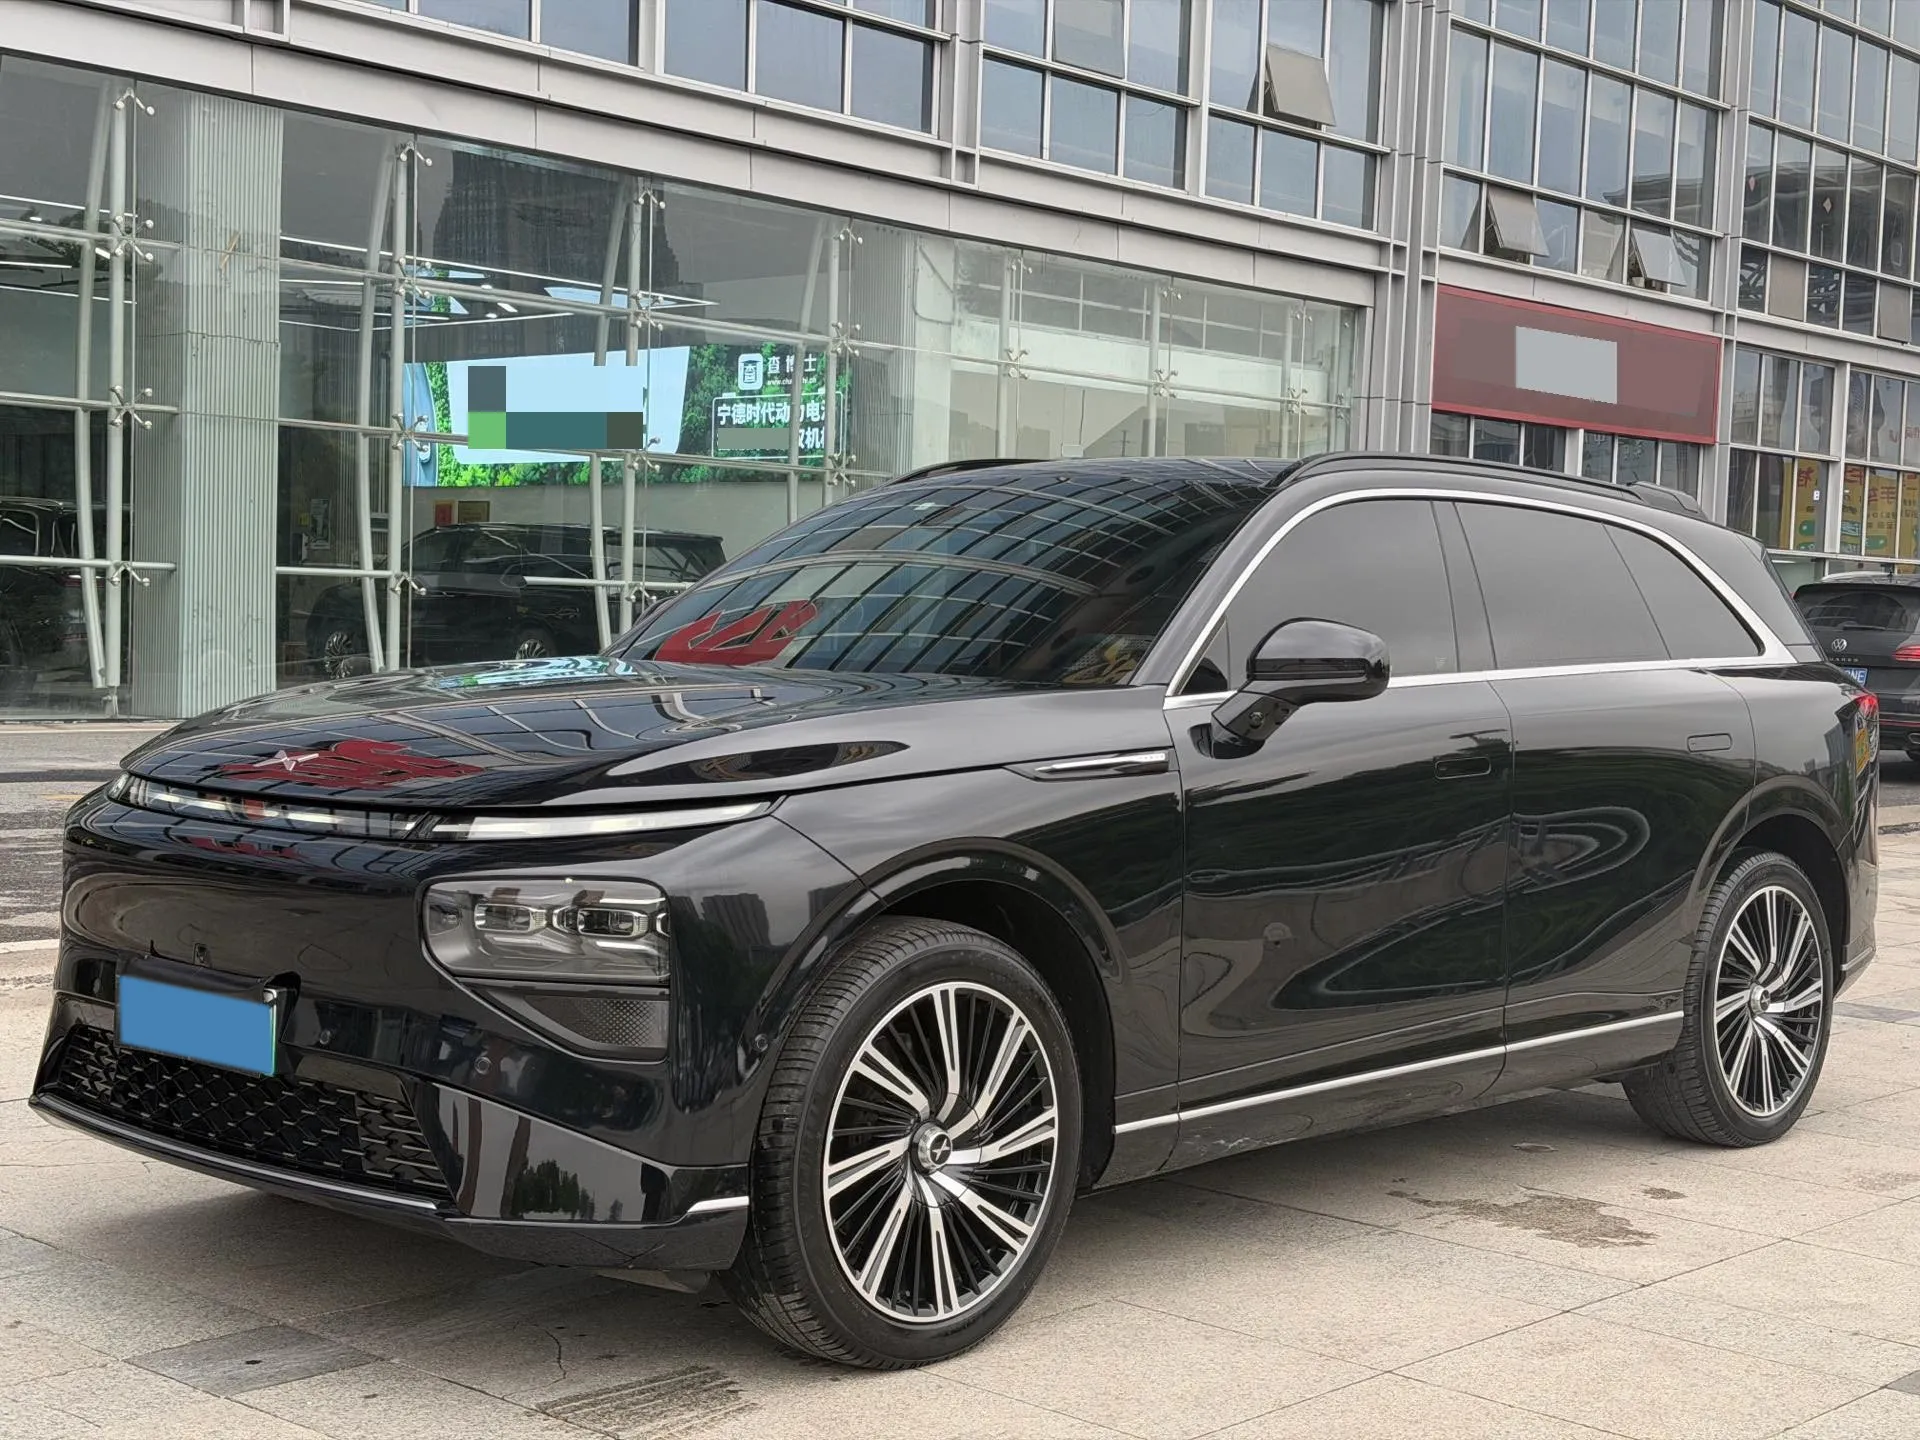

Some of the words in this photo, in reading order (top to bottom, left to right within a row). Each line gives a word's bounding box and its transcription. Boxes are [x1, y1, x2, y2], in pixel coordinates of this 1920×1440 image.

[767, 377, 817, 385] www.chahi.cn
[717, 400, 825, 425] 宁德时代动电
